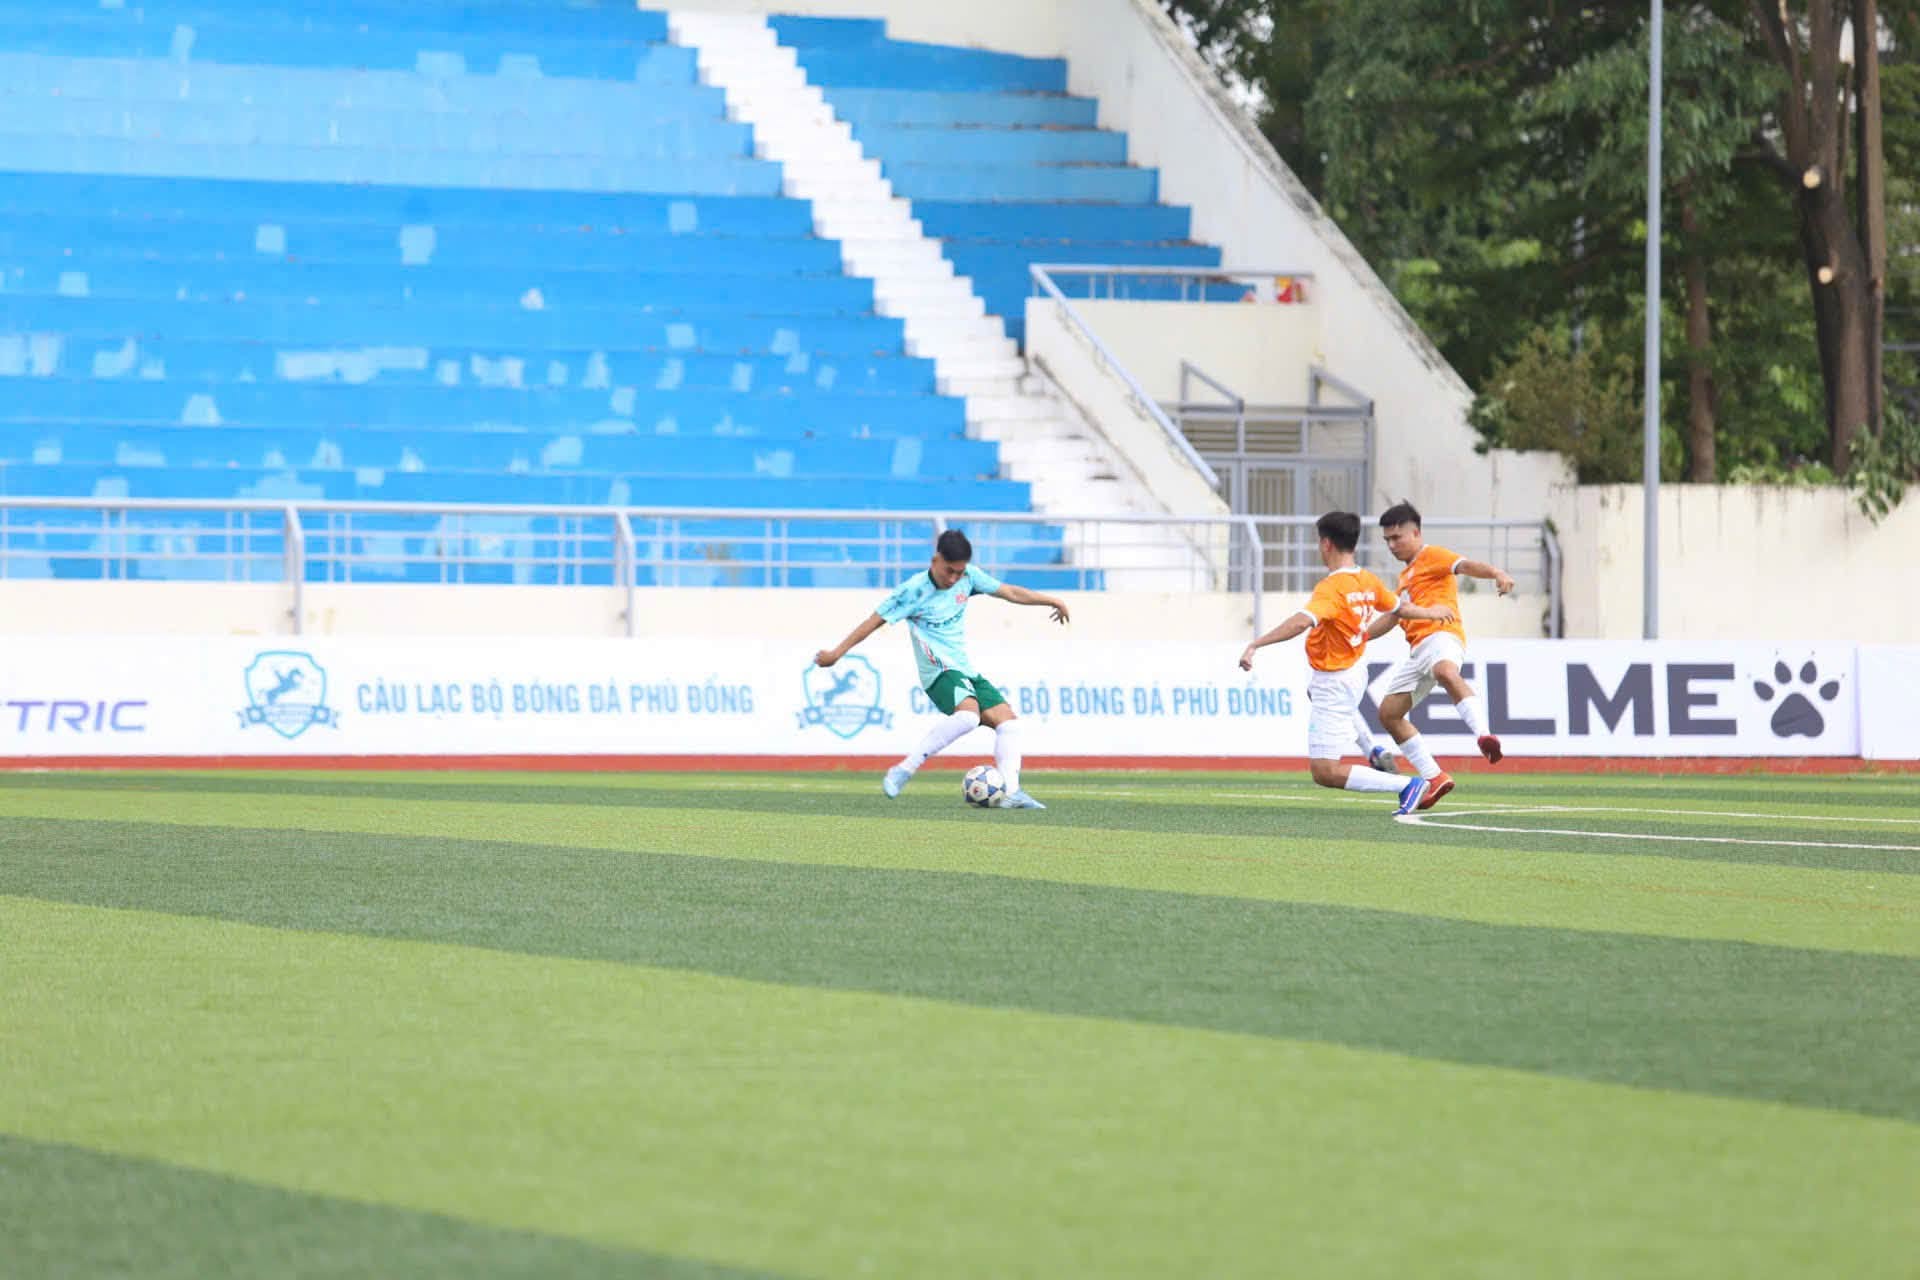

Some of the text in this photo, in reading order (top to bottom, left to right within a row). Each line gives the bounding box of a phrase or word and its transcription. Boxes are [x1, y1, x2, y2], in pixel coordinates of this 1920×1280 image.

[0, 701, 147, 731] TRIC
[415, 684, 463, 719] LẠC
[471, 677, 504, 720] BỘ
[512, 677, 580, 713] BÓNG
[588, 677, 622, 713] ĐÁ
[1020, 680, 1050, 722] BỘ
[1060, 680, 1124, 716] BÓNG
[1133, 680, 1165, 716] ĐÁ
